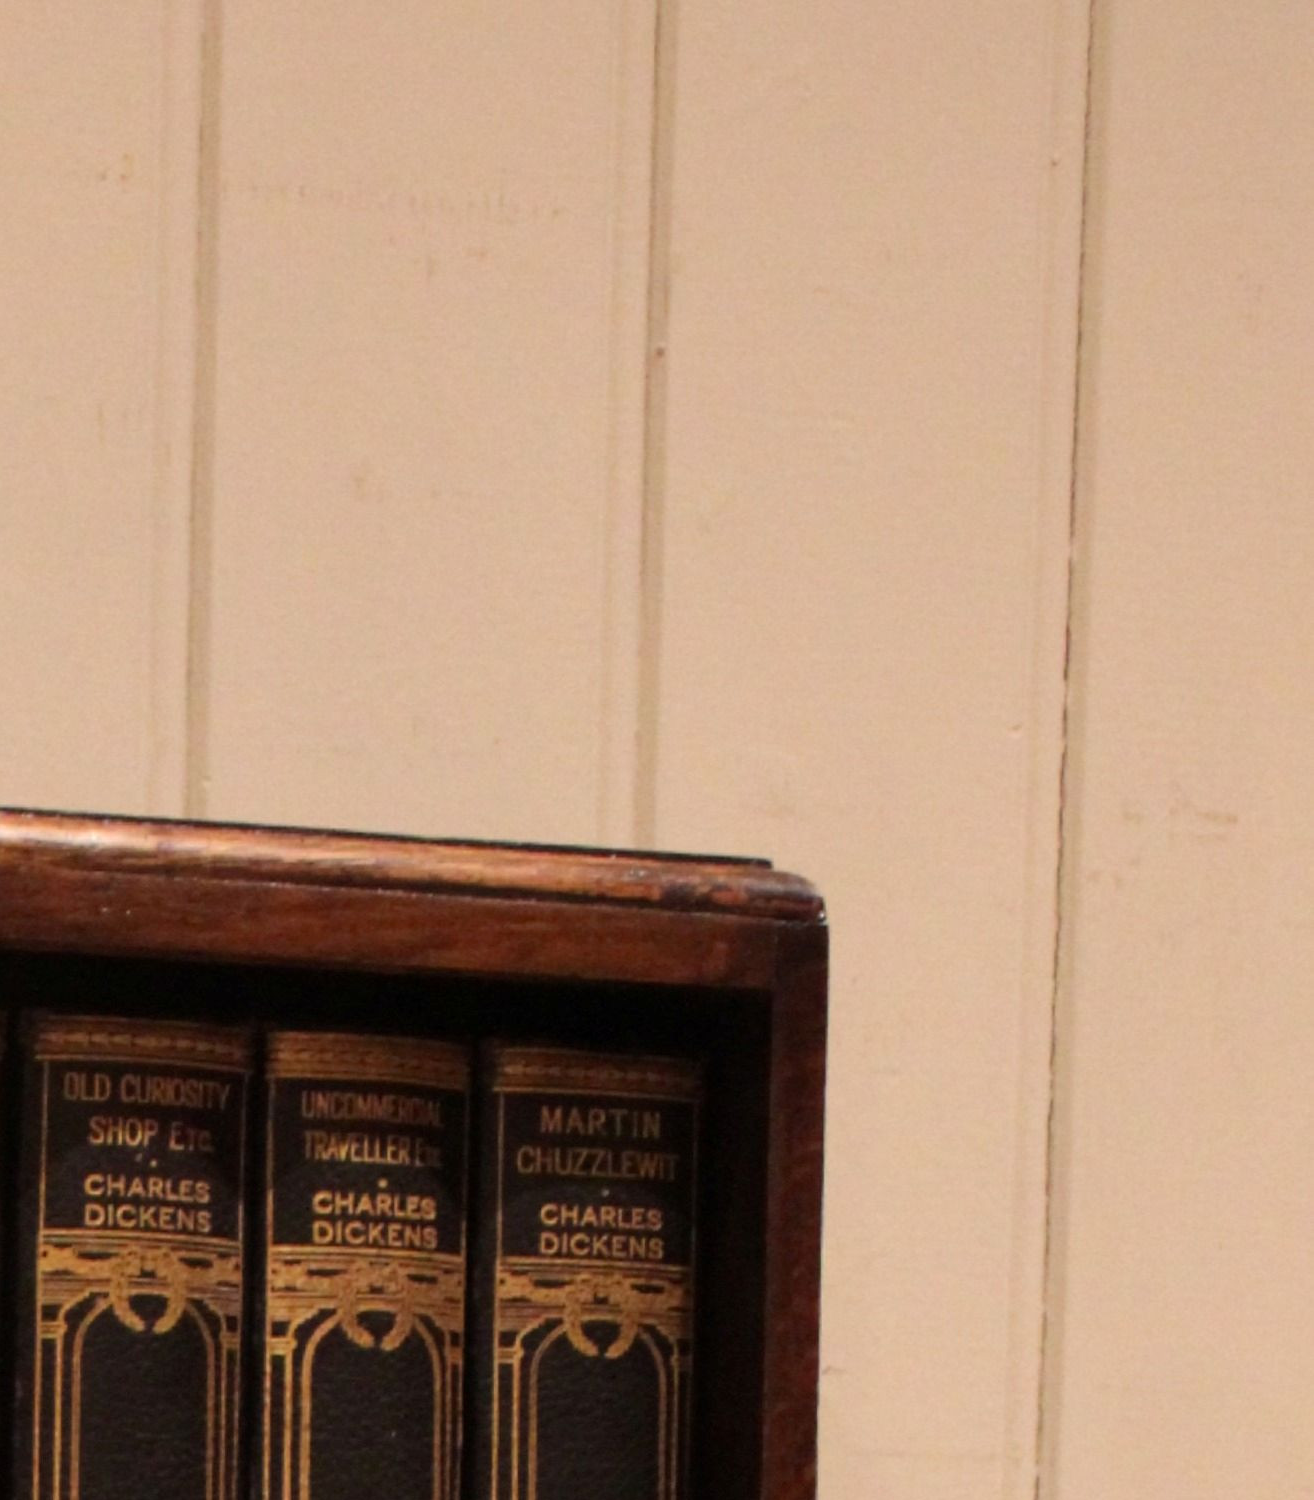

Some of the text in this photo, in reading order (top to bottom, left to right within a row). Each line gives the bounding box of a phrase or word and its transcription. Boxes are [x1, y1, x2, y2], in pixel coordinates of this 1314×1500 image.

[63, 1071, 230, 1110] OLD CURIOSITY
[300, 1089, 442, 1127] UNCOMMERCIAL
[540, 1106, 661, 1140] MARTIN
[88, 1116, 159, 1149] SHOP
[303, 1131, 410, 1166] TRAVELLER
[516, 1145, 679, 1181] CHUZZLEWIT
[85, 1173, 211, 1203] CHARLES
[84, 1203, 212, 1233] DICKENS
[312, 1190, 436, 1221] CHARLES
[540, 1203, 663, 1232] CHARLES
[312, 1219, 438, 1249] DICKENS
[539, 1231, 664, 1260] DICKENS
